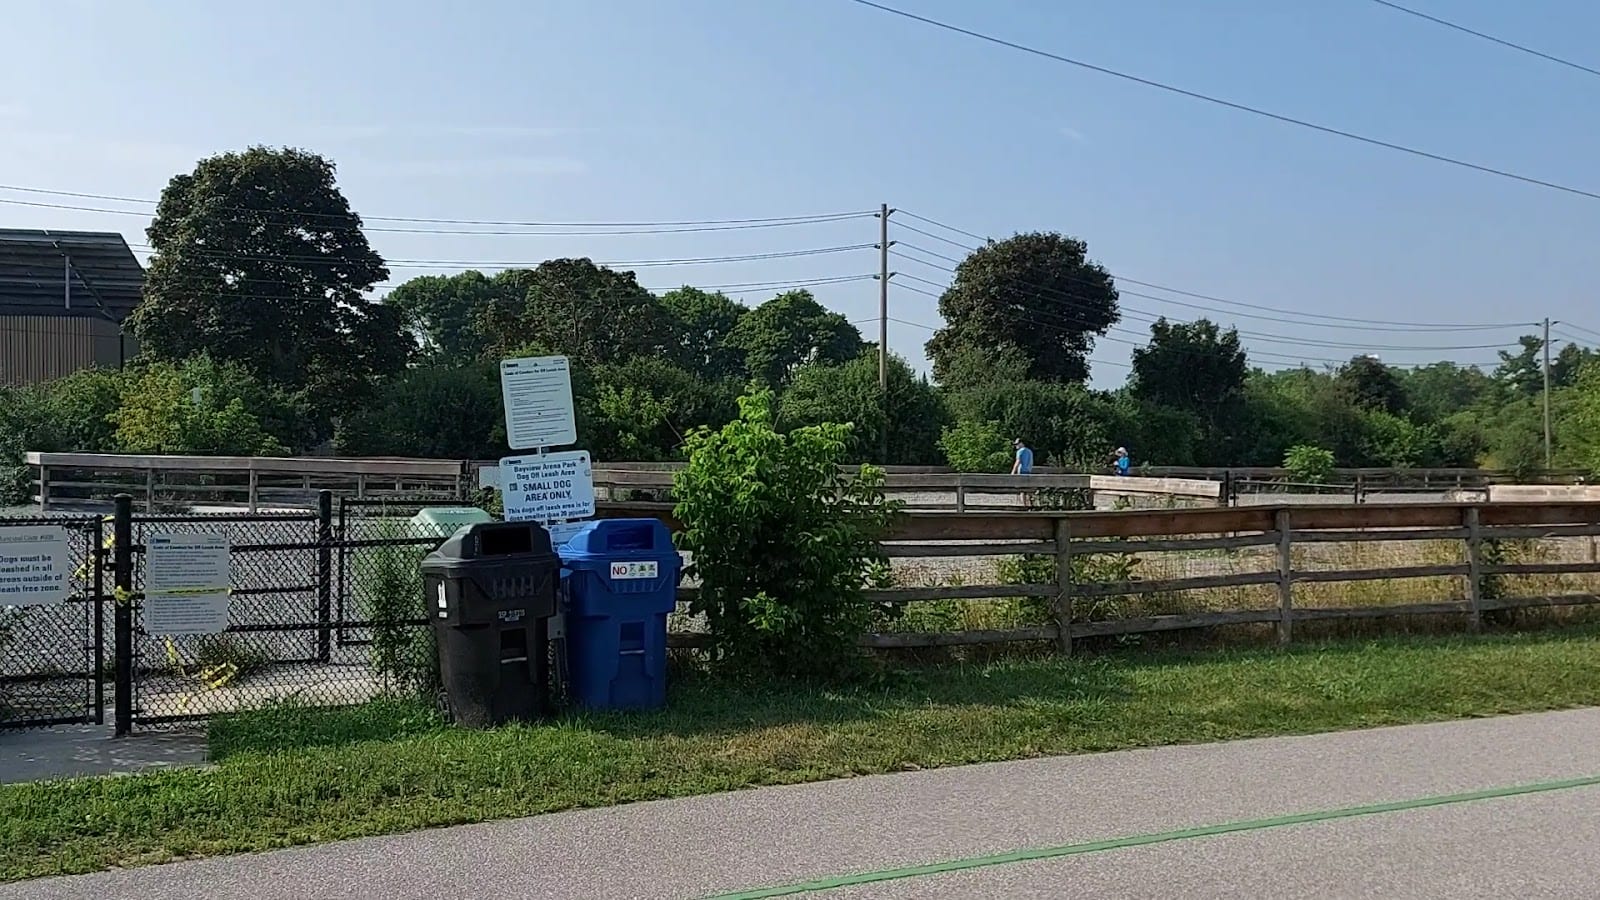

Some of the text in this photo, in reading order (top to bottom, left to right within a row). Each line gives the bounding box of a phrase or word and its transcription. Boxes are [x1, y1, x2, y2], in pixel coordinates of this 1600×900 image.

[514, 465, 541, 473] Bayview
[541, 470, 559, 478] Leash
[523, 480, 572, 492] SMALL DOG
[525, 490, 571, 502] AREA ONLY
[32, 564, 40, 572] in
[42, 563, 52, 571] all
[612, 566, 628, 576] NO
[23, 574, 52, 582] outside
[55, 573, 62, 581] of
[41, 584, 62, 592] zone.
